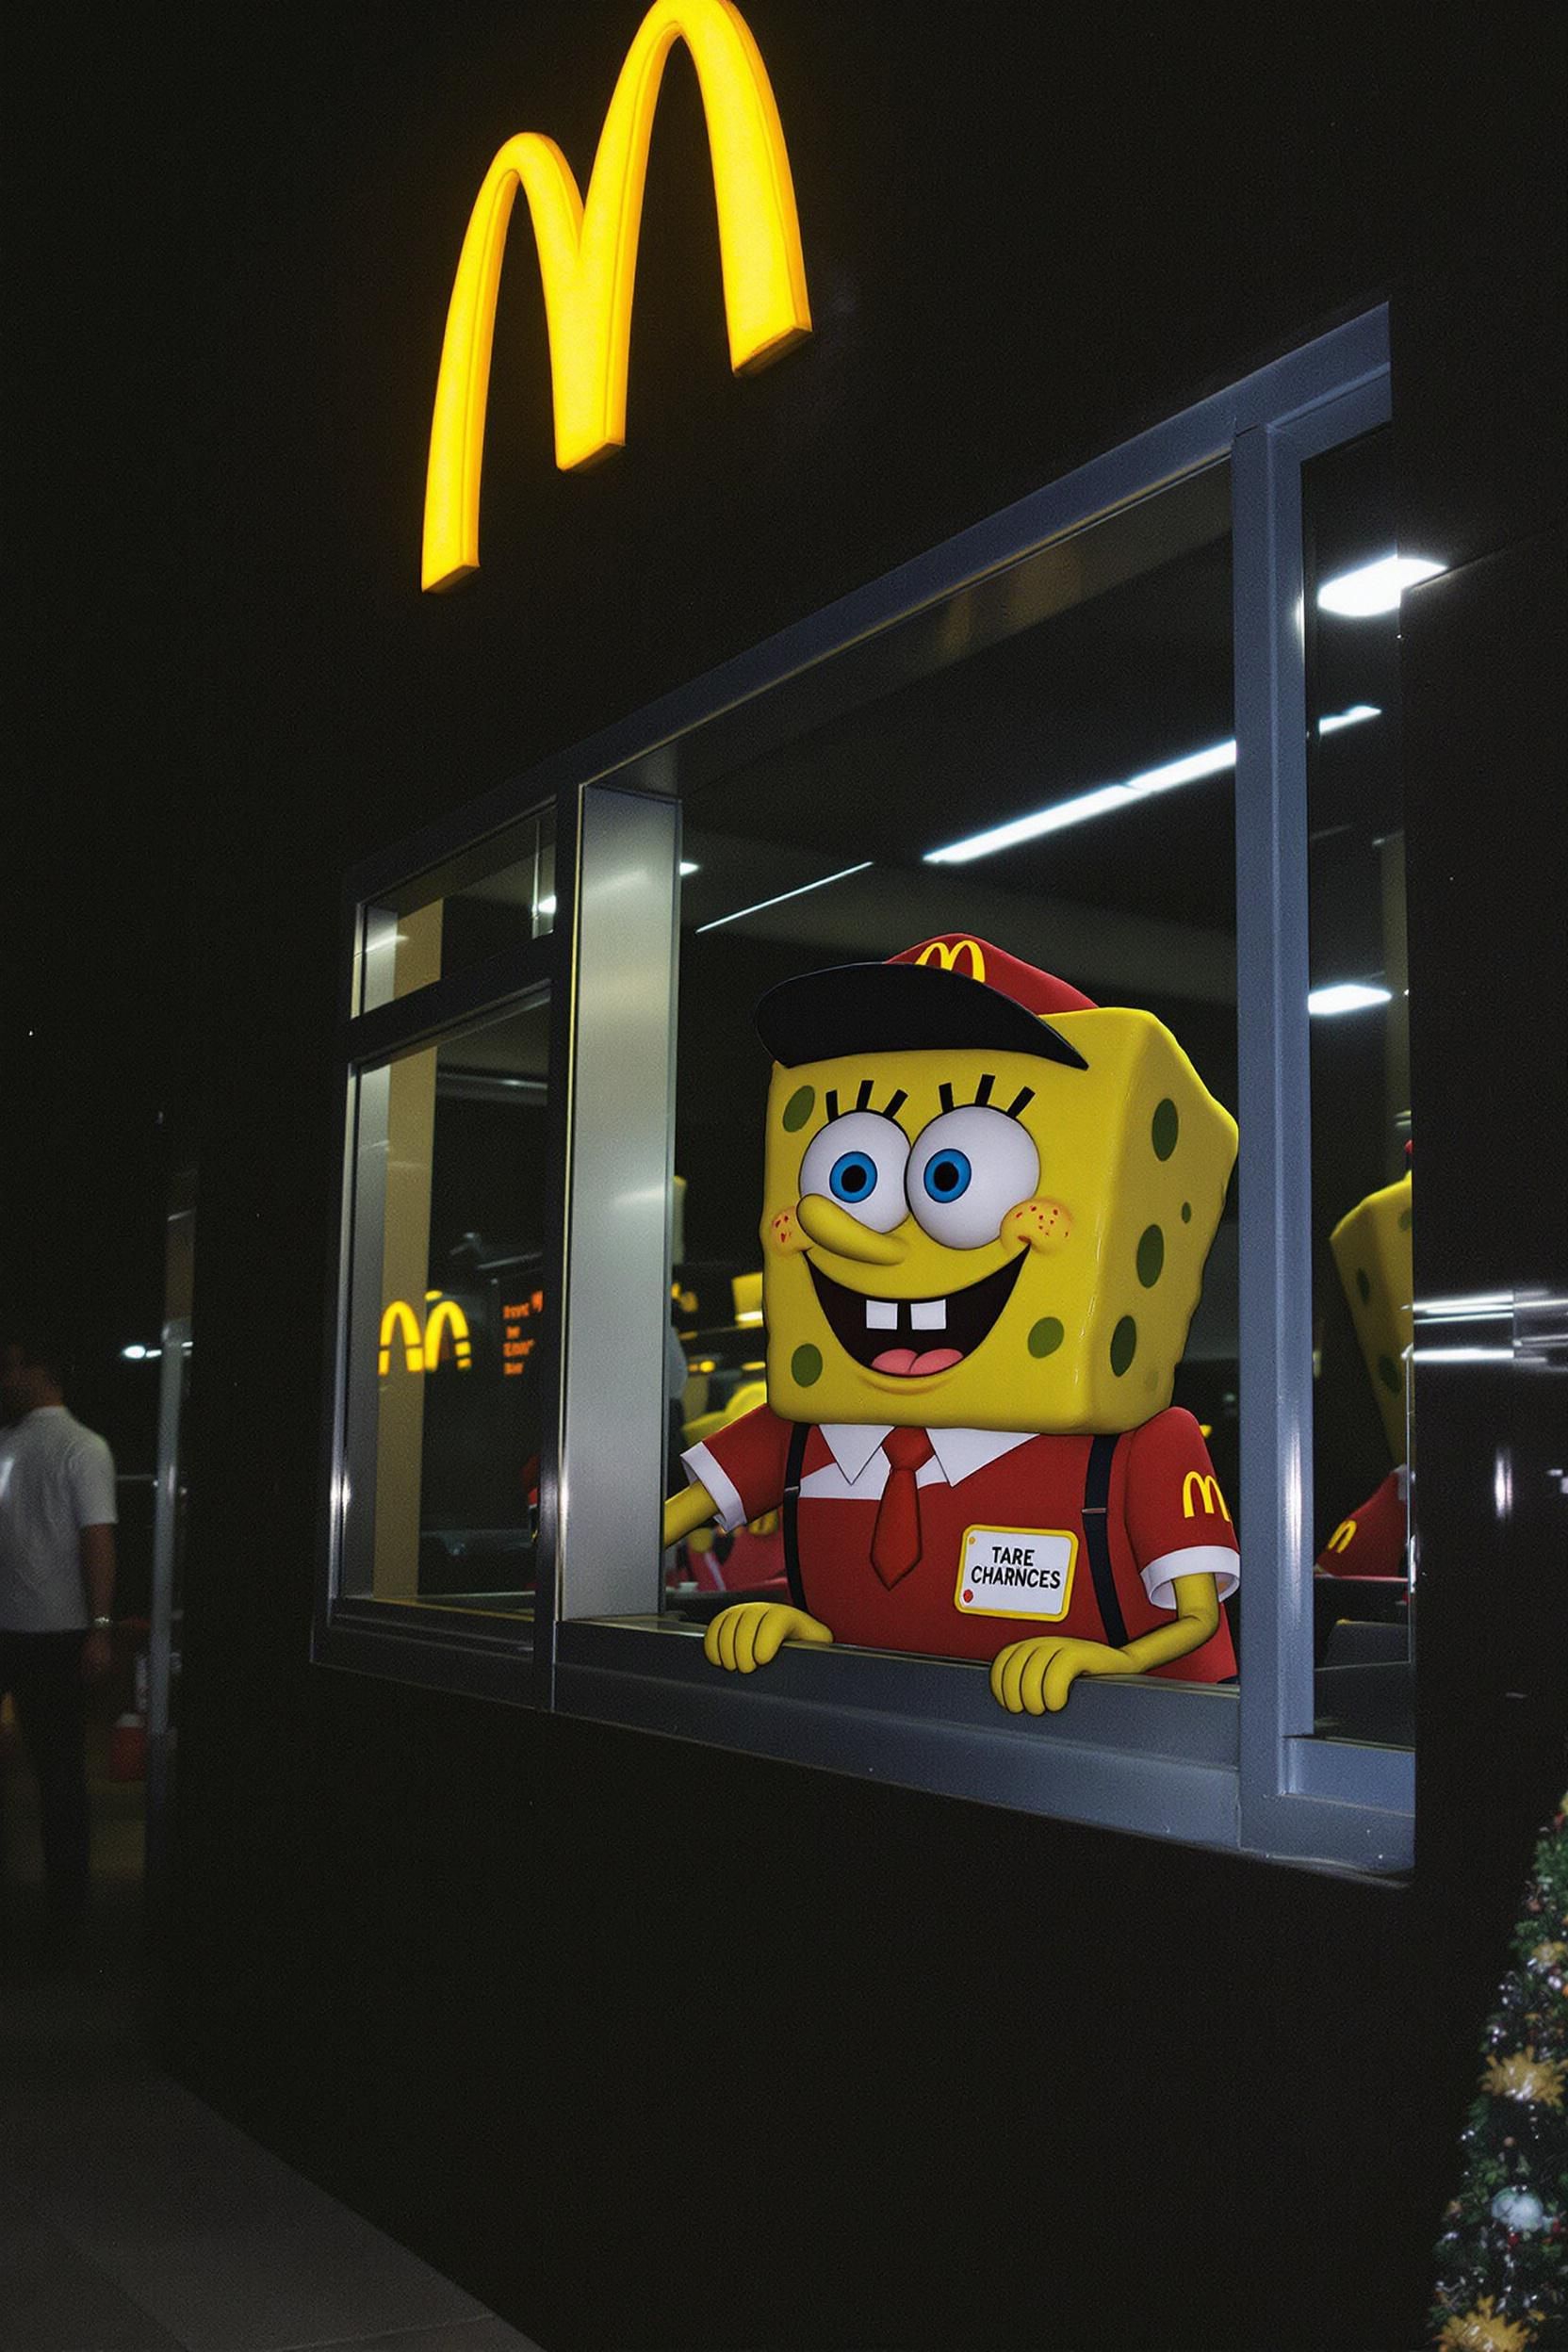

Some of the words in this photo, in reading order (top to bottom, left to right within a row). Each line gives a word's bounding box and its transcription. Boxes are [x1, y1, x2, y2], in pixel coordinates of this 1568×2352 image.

[421, 0, 812, 593] M
[991, 1546, 1035, 1566] TARE
[971, 1565, 1061, 1590] CHARNCES
